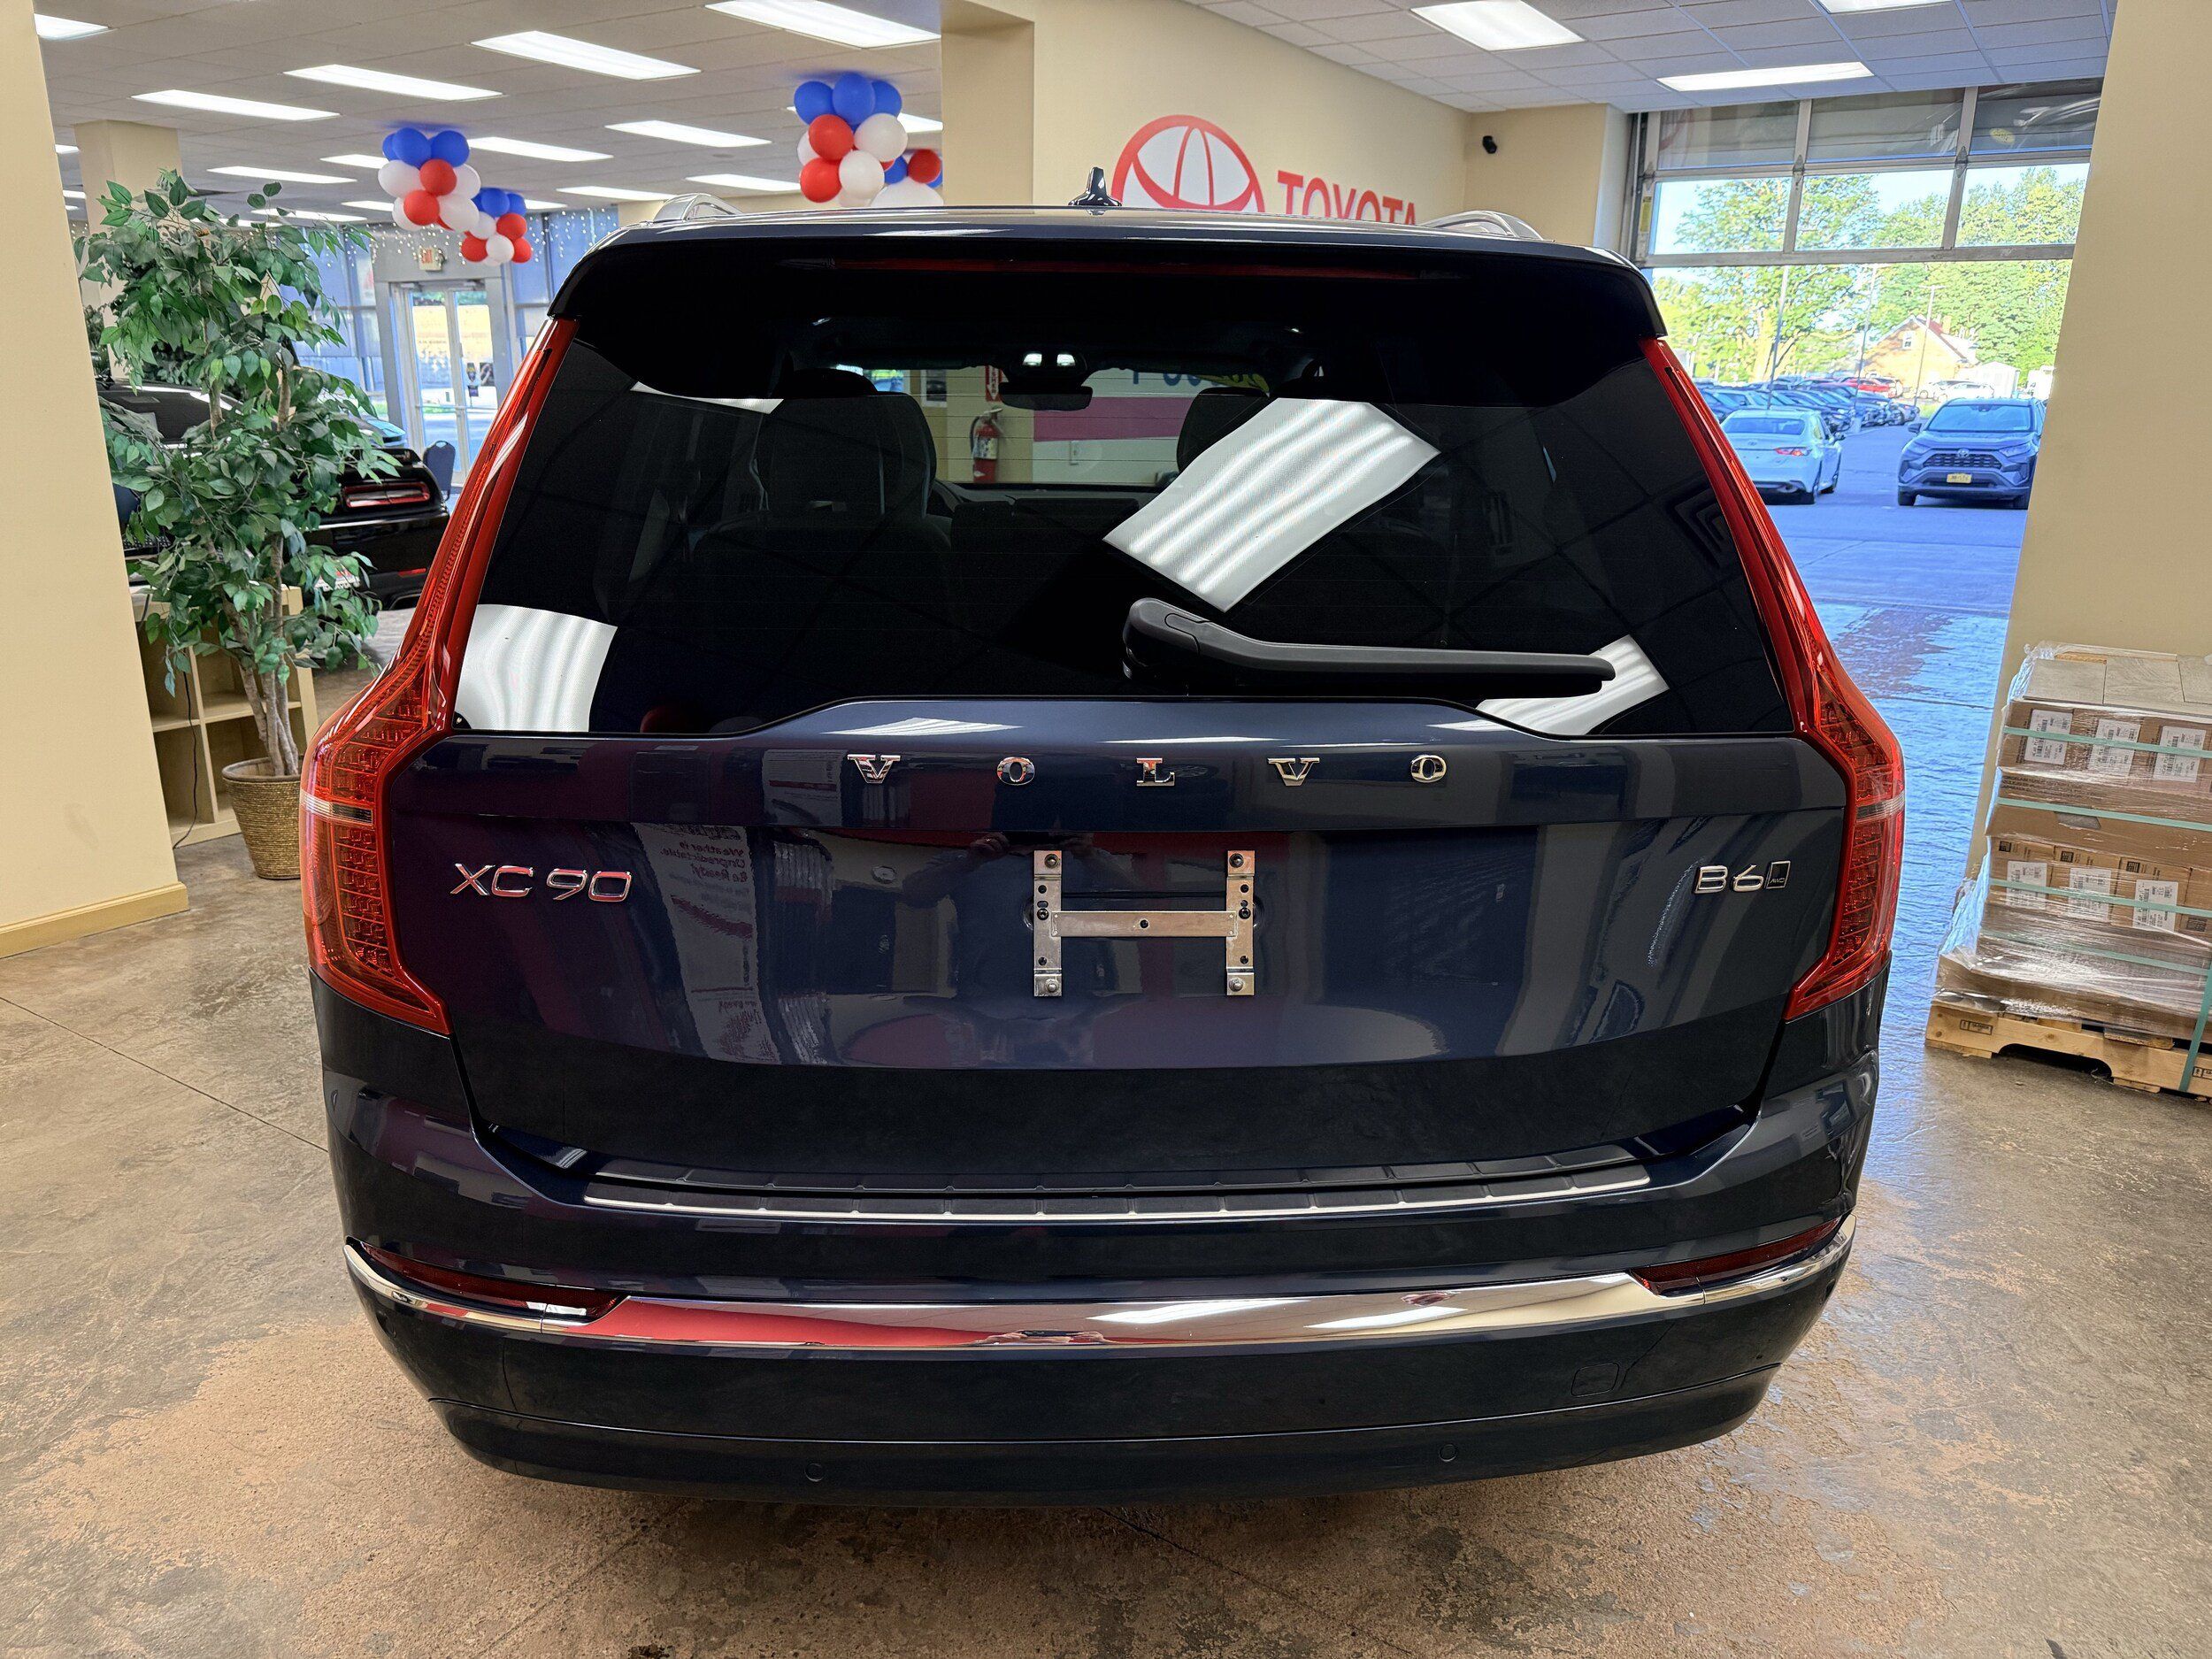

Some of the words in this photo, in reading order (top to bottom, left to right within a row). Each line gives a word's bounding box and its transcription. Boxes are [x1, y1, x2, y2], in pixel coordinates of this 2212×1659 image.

[847, 753, 1448, 787] VOLVO
[546, 868, 633, 902] 90
[1694, 864, 1764, 895] B6
